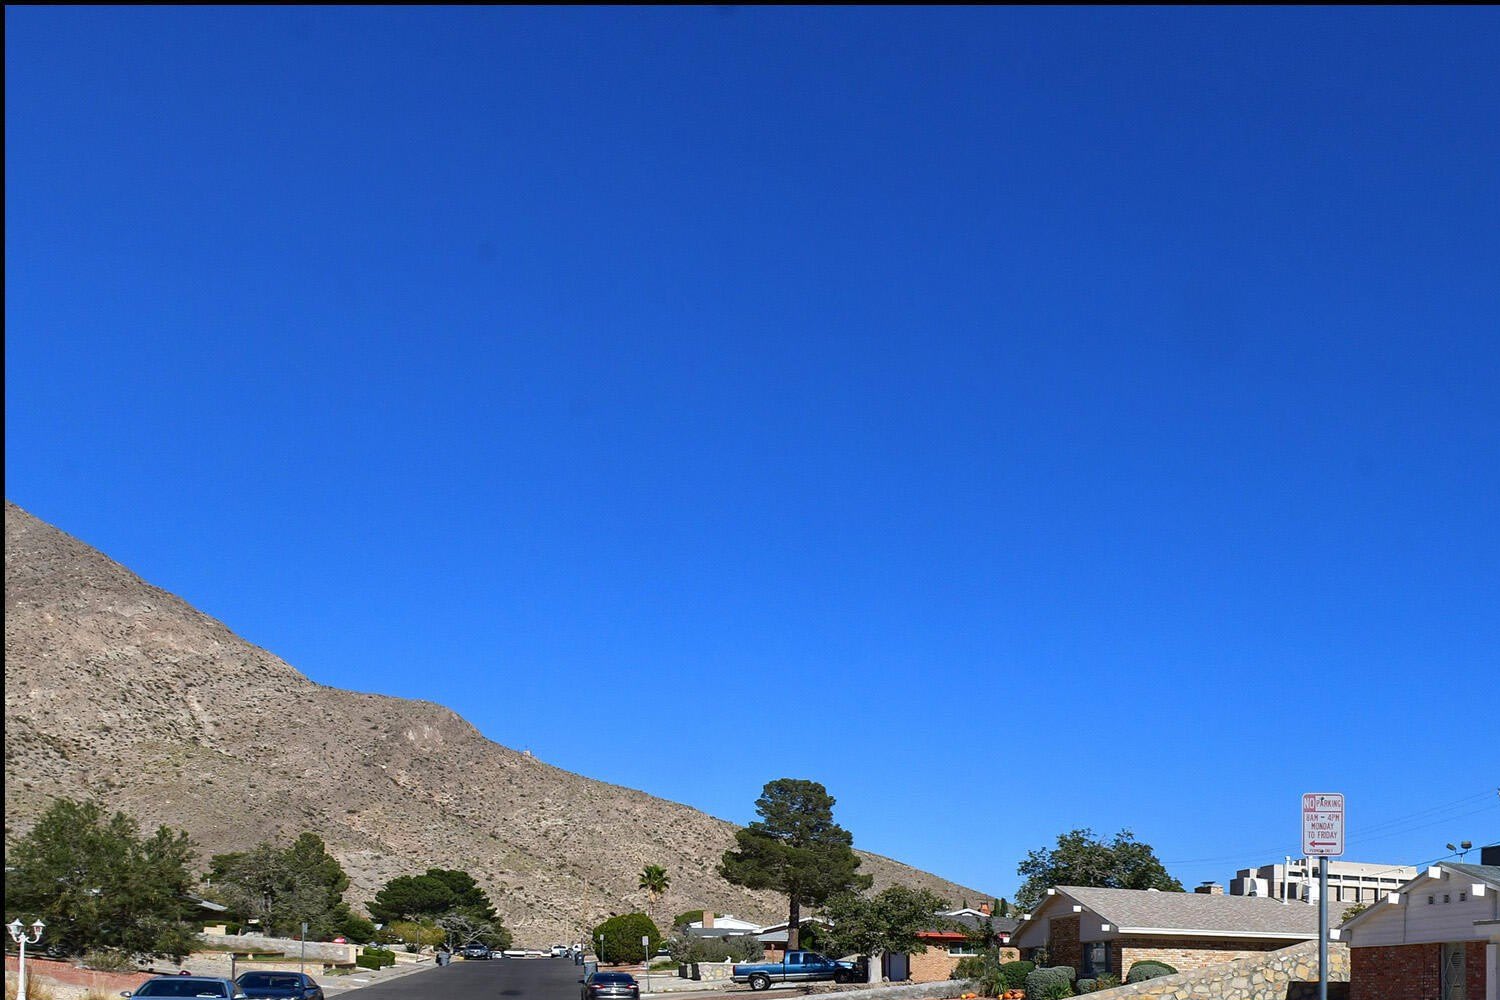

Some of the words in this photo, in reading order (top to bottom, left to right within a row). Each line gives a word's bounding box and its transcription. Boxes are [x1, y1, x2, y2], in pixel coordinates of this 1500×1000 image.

[1304, 797, 1315, 809] NO
[1316, 800, 1341, 808] PARKING
[1311, 822, 1334, 830] MONDAY
[1308, 831, 1316, 839] TO
[1317, 831, 1338, 839] FRIDAY
